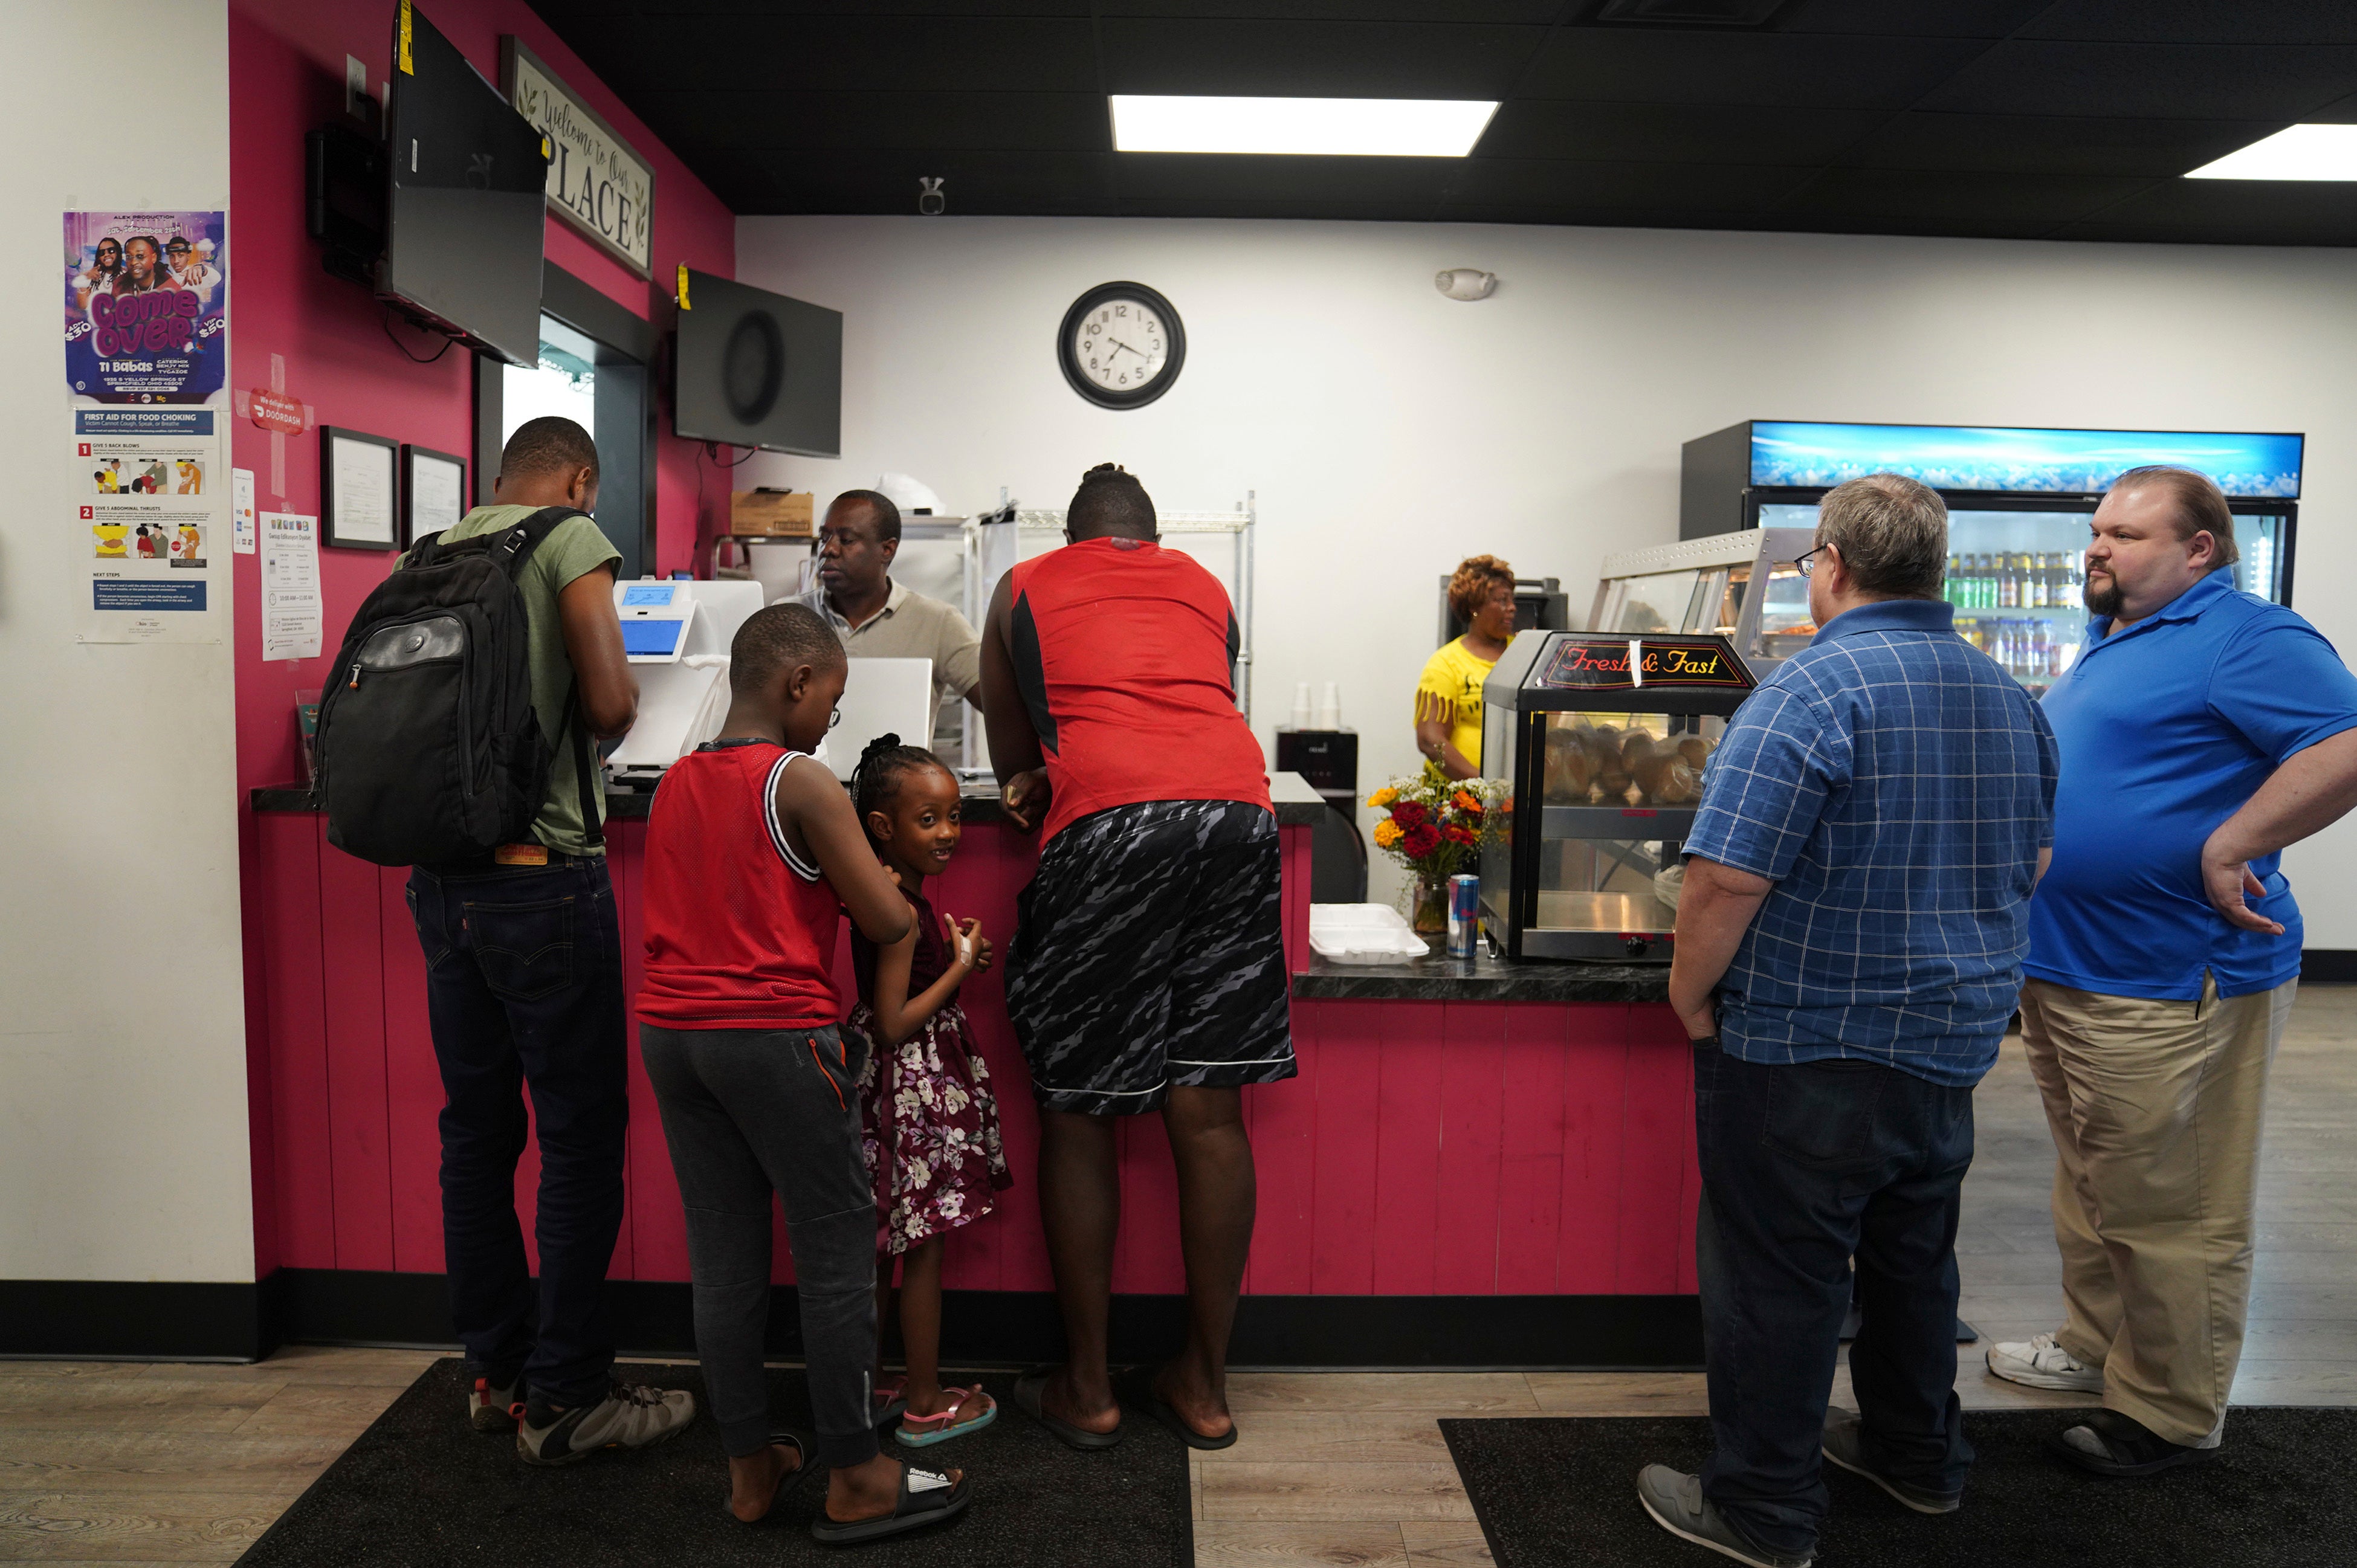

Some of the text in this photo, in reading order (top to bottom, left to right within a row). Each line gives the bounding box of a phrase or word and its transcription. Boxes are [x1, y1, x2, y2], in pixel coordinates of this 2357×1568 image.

[544, 90, 630, 193] Welcome to Our
[538, 124, 631, 251] PLACE
[1116, 306, 1127, 317] 12
[1137, 310, 1141, 321] 1
[204, 318, 216, 326] VIP
[1148, 321, 1154, 332] 2
[65, 323, 91, 341] $30
[199, 319, 225, 337] $50
[1086, 324, 1101, 335] 10
[1084, 341, 1092, 353] 9
[1153, 339, 1159, 350] 3
[1090, 358, 1098, 369] 8
[1102, 369, 1110, 379] 7
[1119, 373, 1127, 384] 6
[1136, 367, 1143, 379] 5
[260, 396, 268, 404] We
[266, 410, 300, 425] DOORDASH
[82, 445, 87, 454] 1
[83, 508, 90, 517] 2
[1562, 648, 1718, 674] Fresh & Fast
[910, 1468, 937, 1479] Reebok
